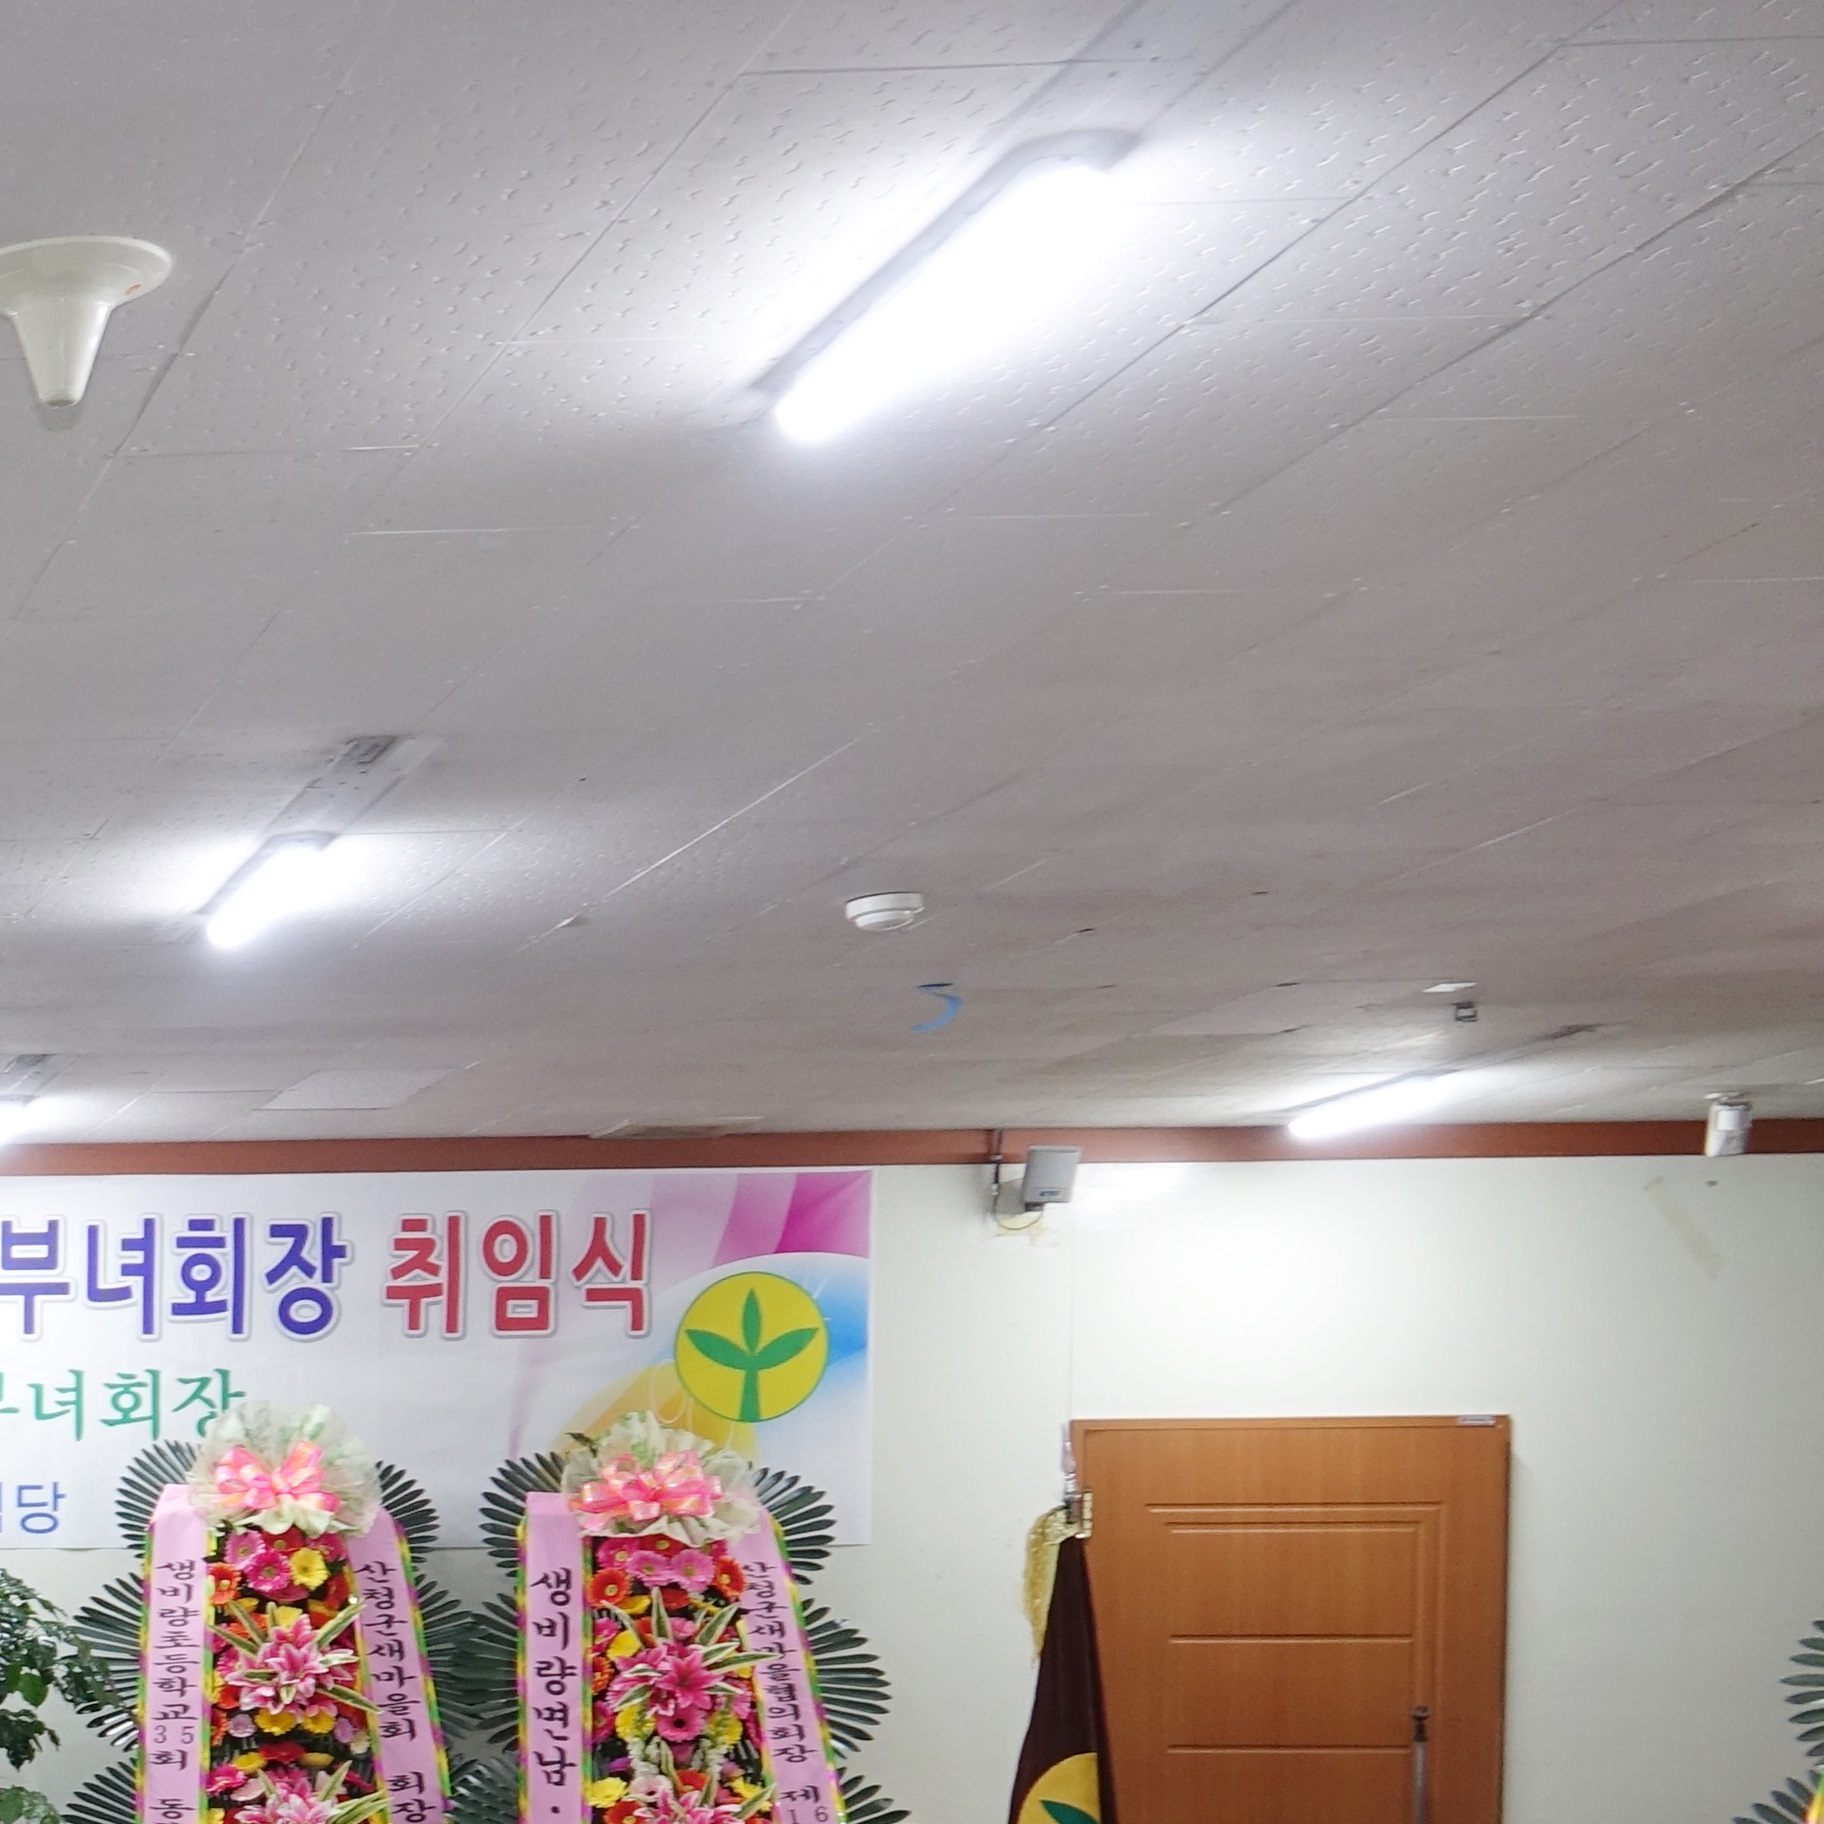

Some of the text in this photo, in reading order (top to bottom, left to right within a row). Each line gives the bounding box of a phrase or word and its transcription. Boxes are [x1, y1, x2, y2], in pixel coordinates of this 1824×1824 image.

[385, 1212, 647, 1335] 취임식
[352, 1561, 421, 1742] 산청군새마을회
[386, 1770, 437, 1823] 회장
